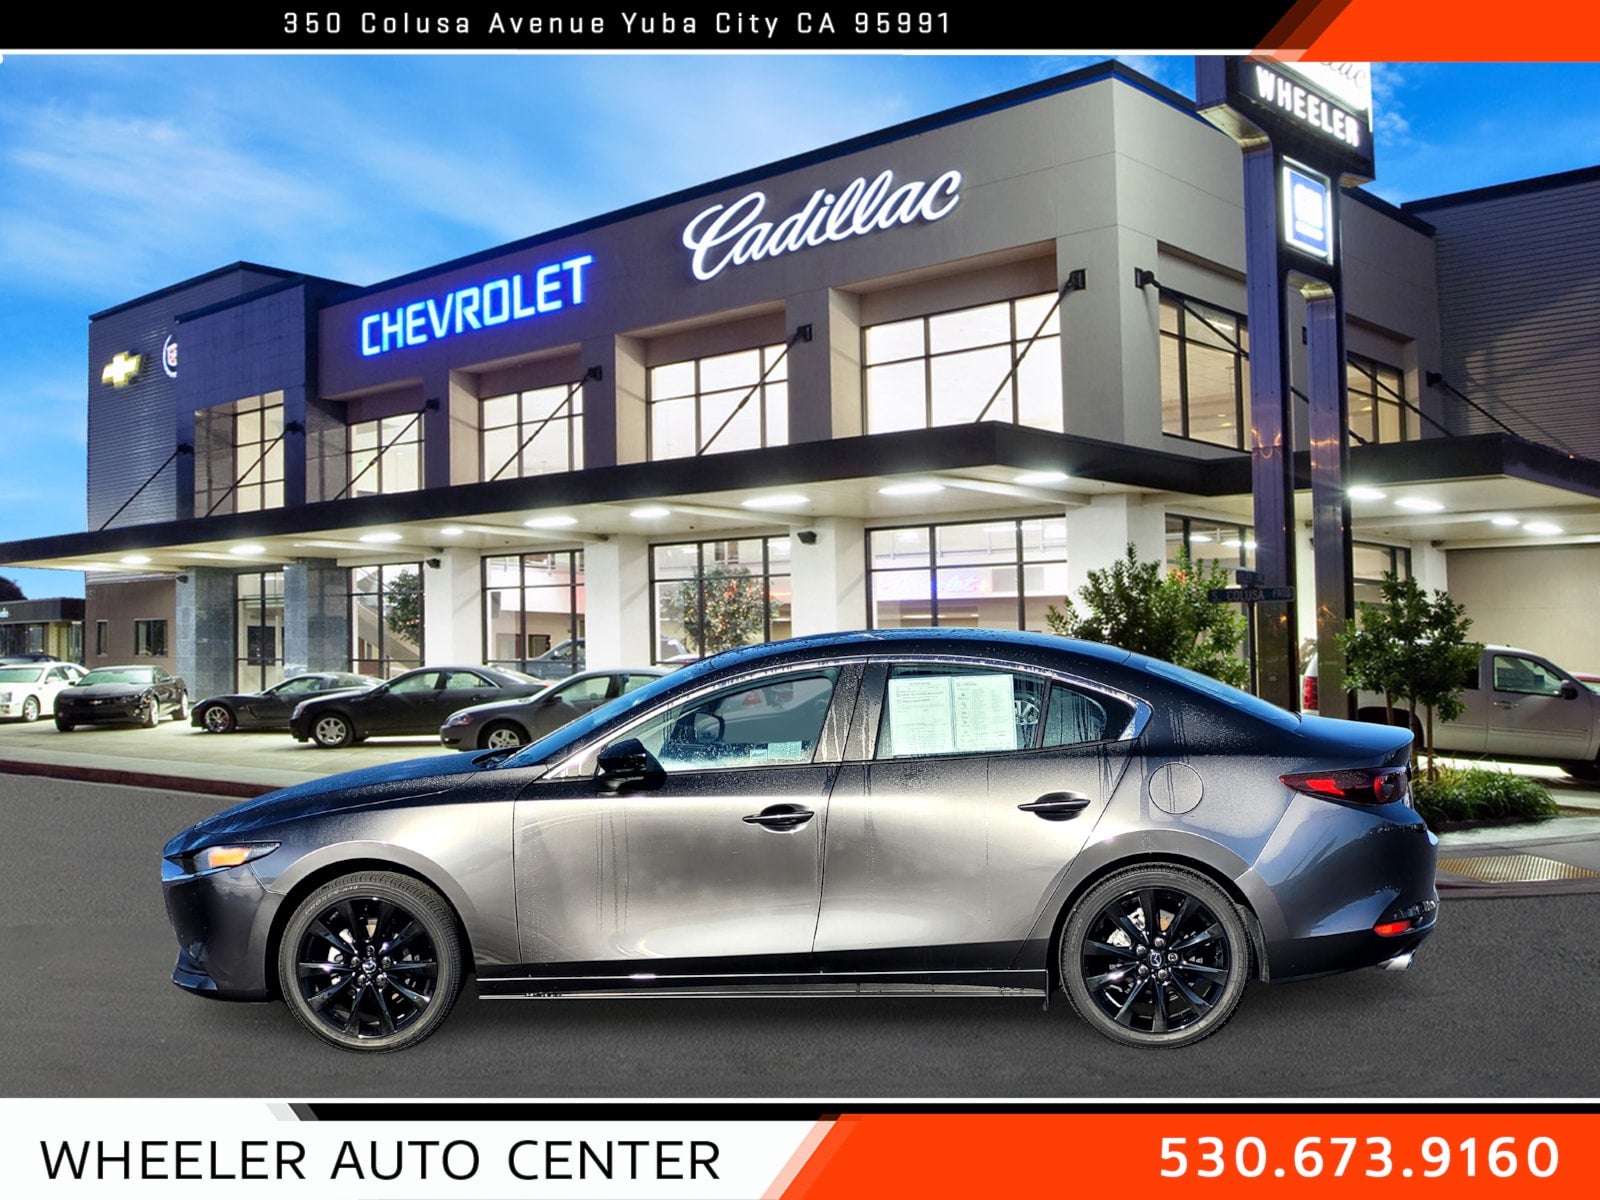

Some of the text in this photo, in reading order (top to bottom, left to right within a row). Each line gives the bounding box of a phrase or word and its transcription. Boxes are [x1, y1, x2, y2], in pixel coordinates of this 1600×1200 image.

[1255, 65, 1361, 148] WHEELER
[682, 169, 962, 281] Cadillac
[361, 254, 594, 357] CHEVROLET
[1226, 589, 1265, 601] COLUSA
